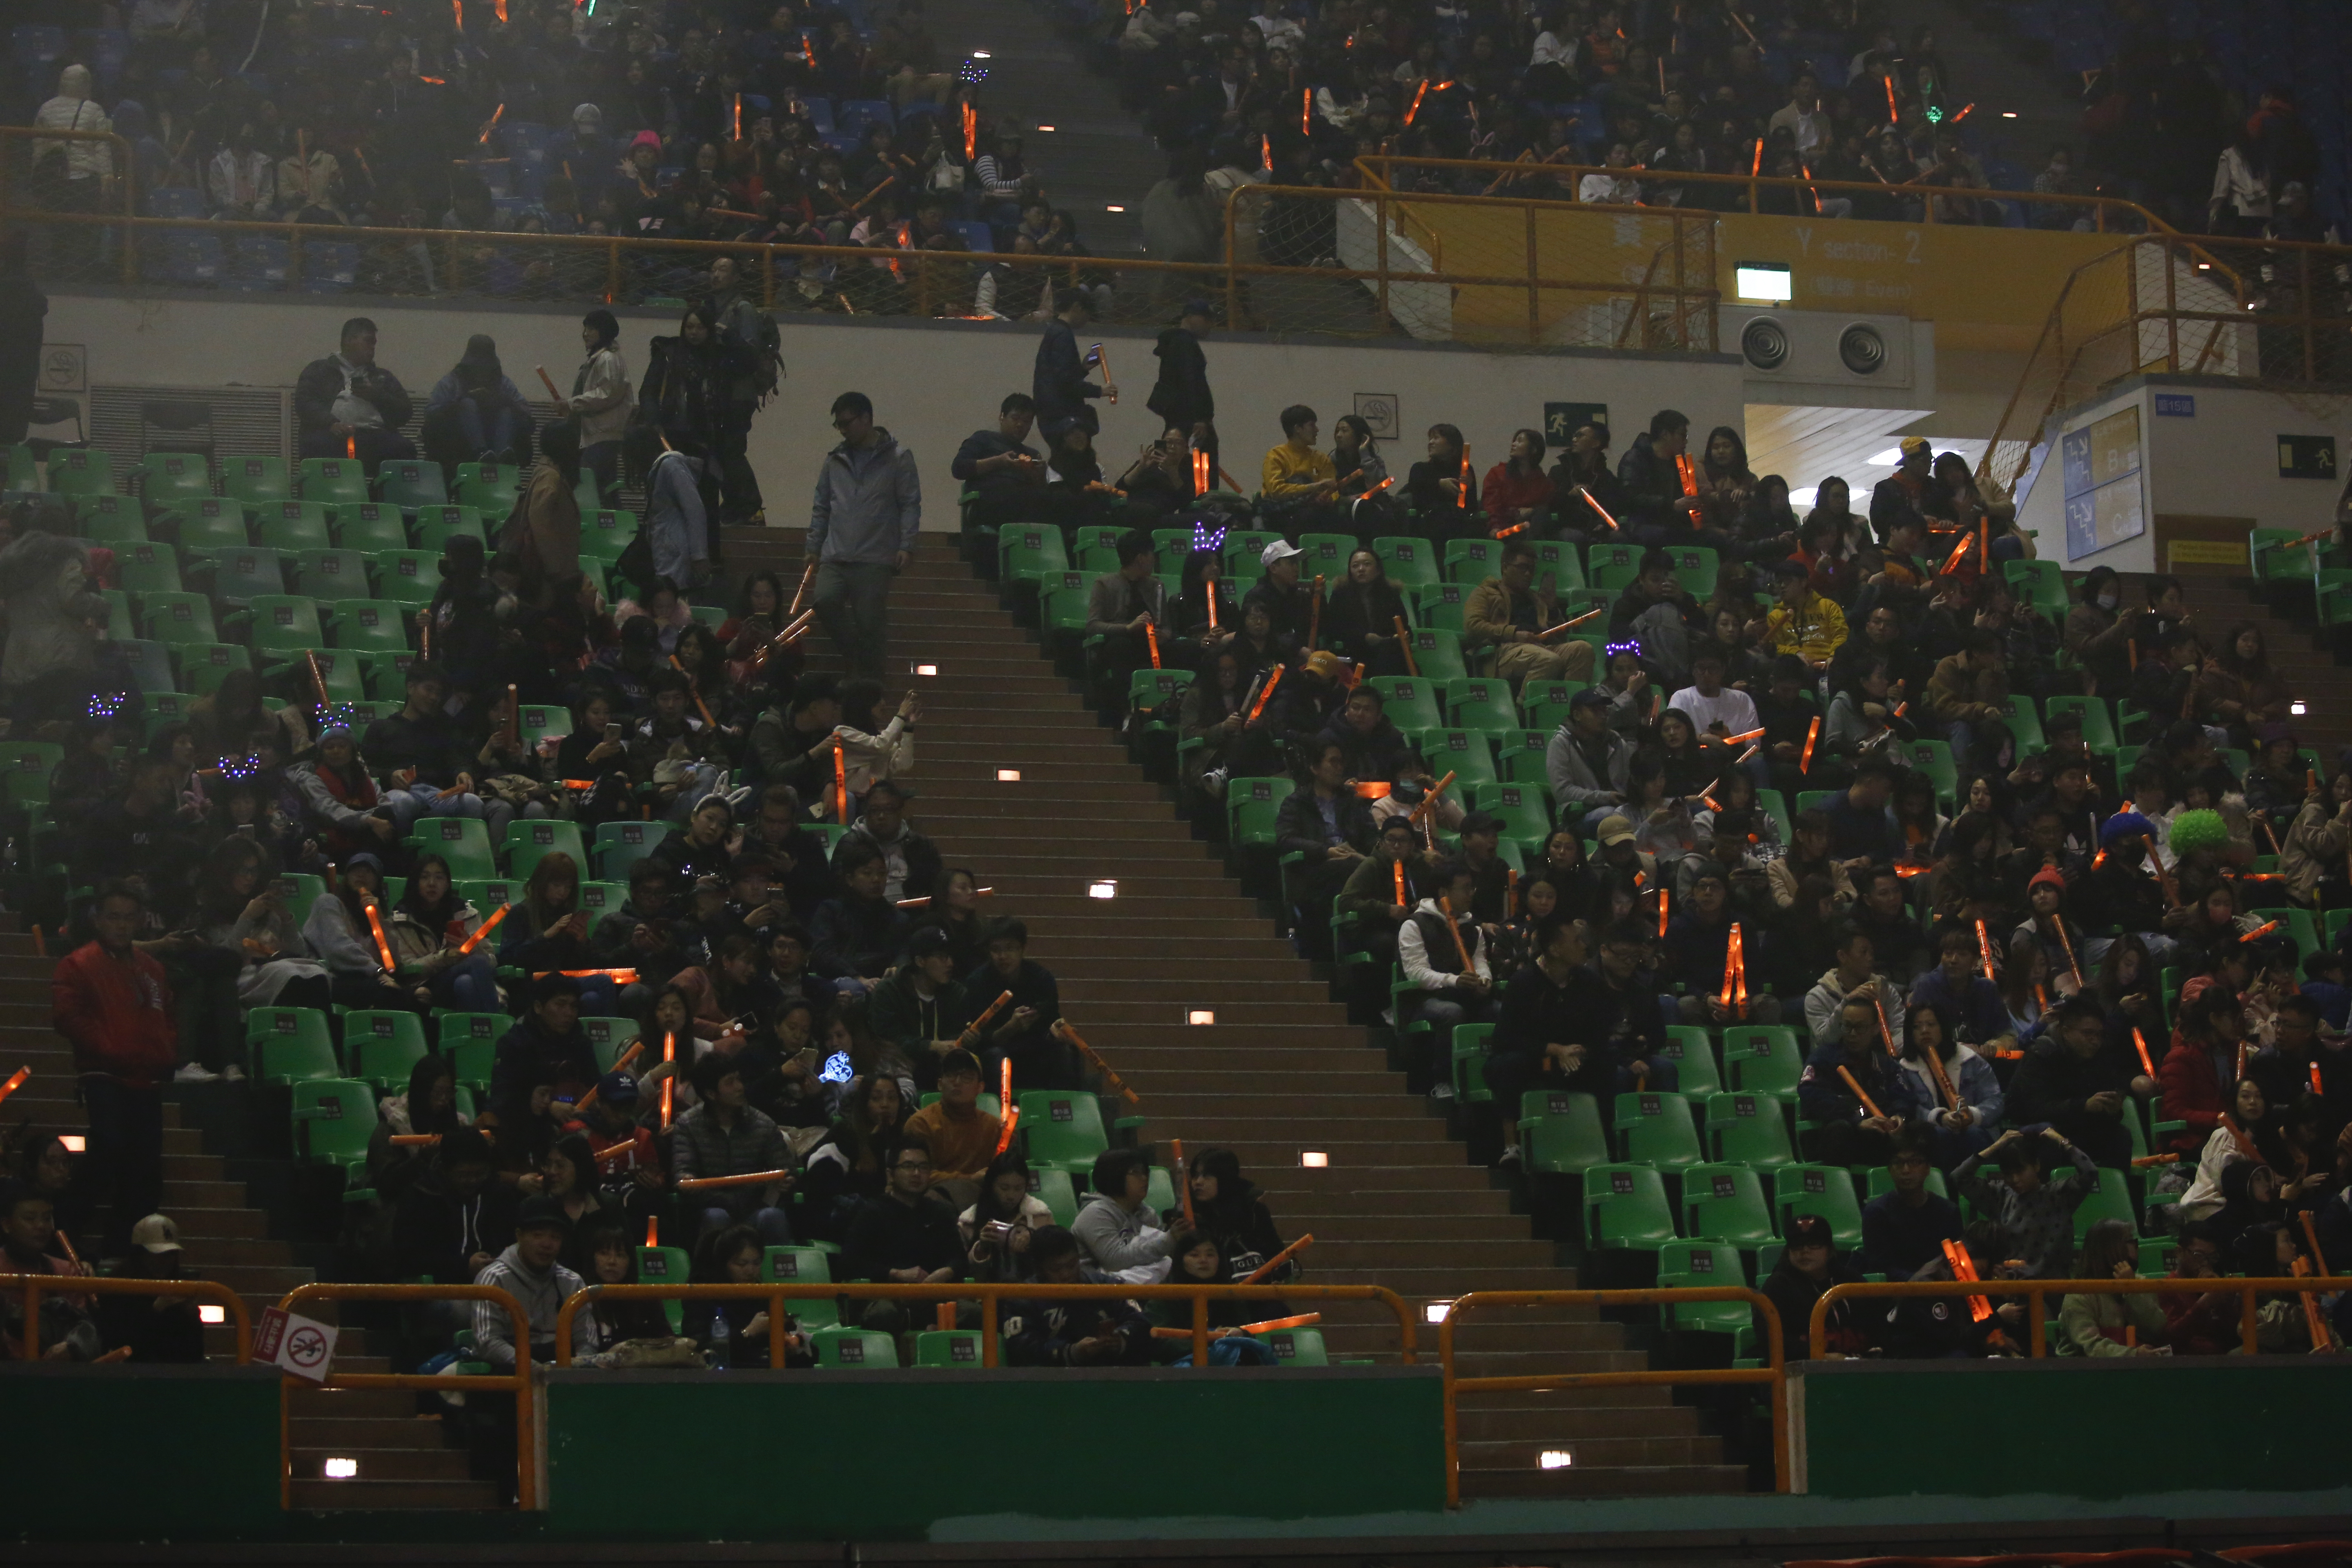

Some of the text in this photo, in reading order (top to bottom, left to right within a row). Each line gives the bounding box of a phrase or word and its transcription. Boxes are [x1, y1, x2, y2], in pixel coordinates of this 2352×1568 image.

[1795, 227, 1813, 257] Y
[1905, 230, 1922, 264] 2
[1237, 1255, 1266, 1268] GUE
